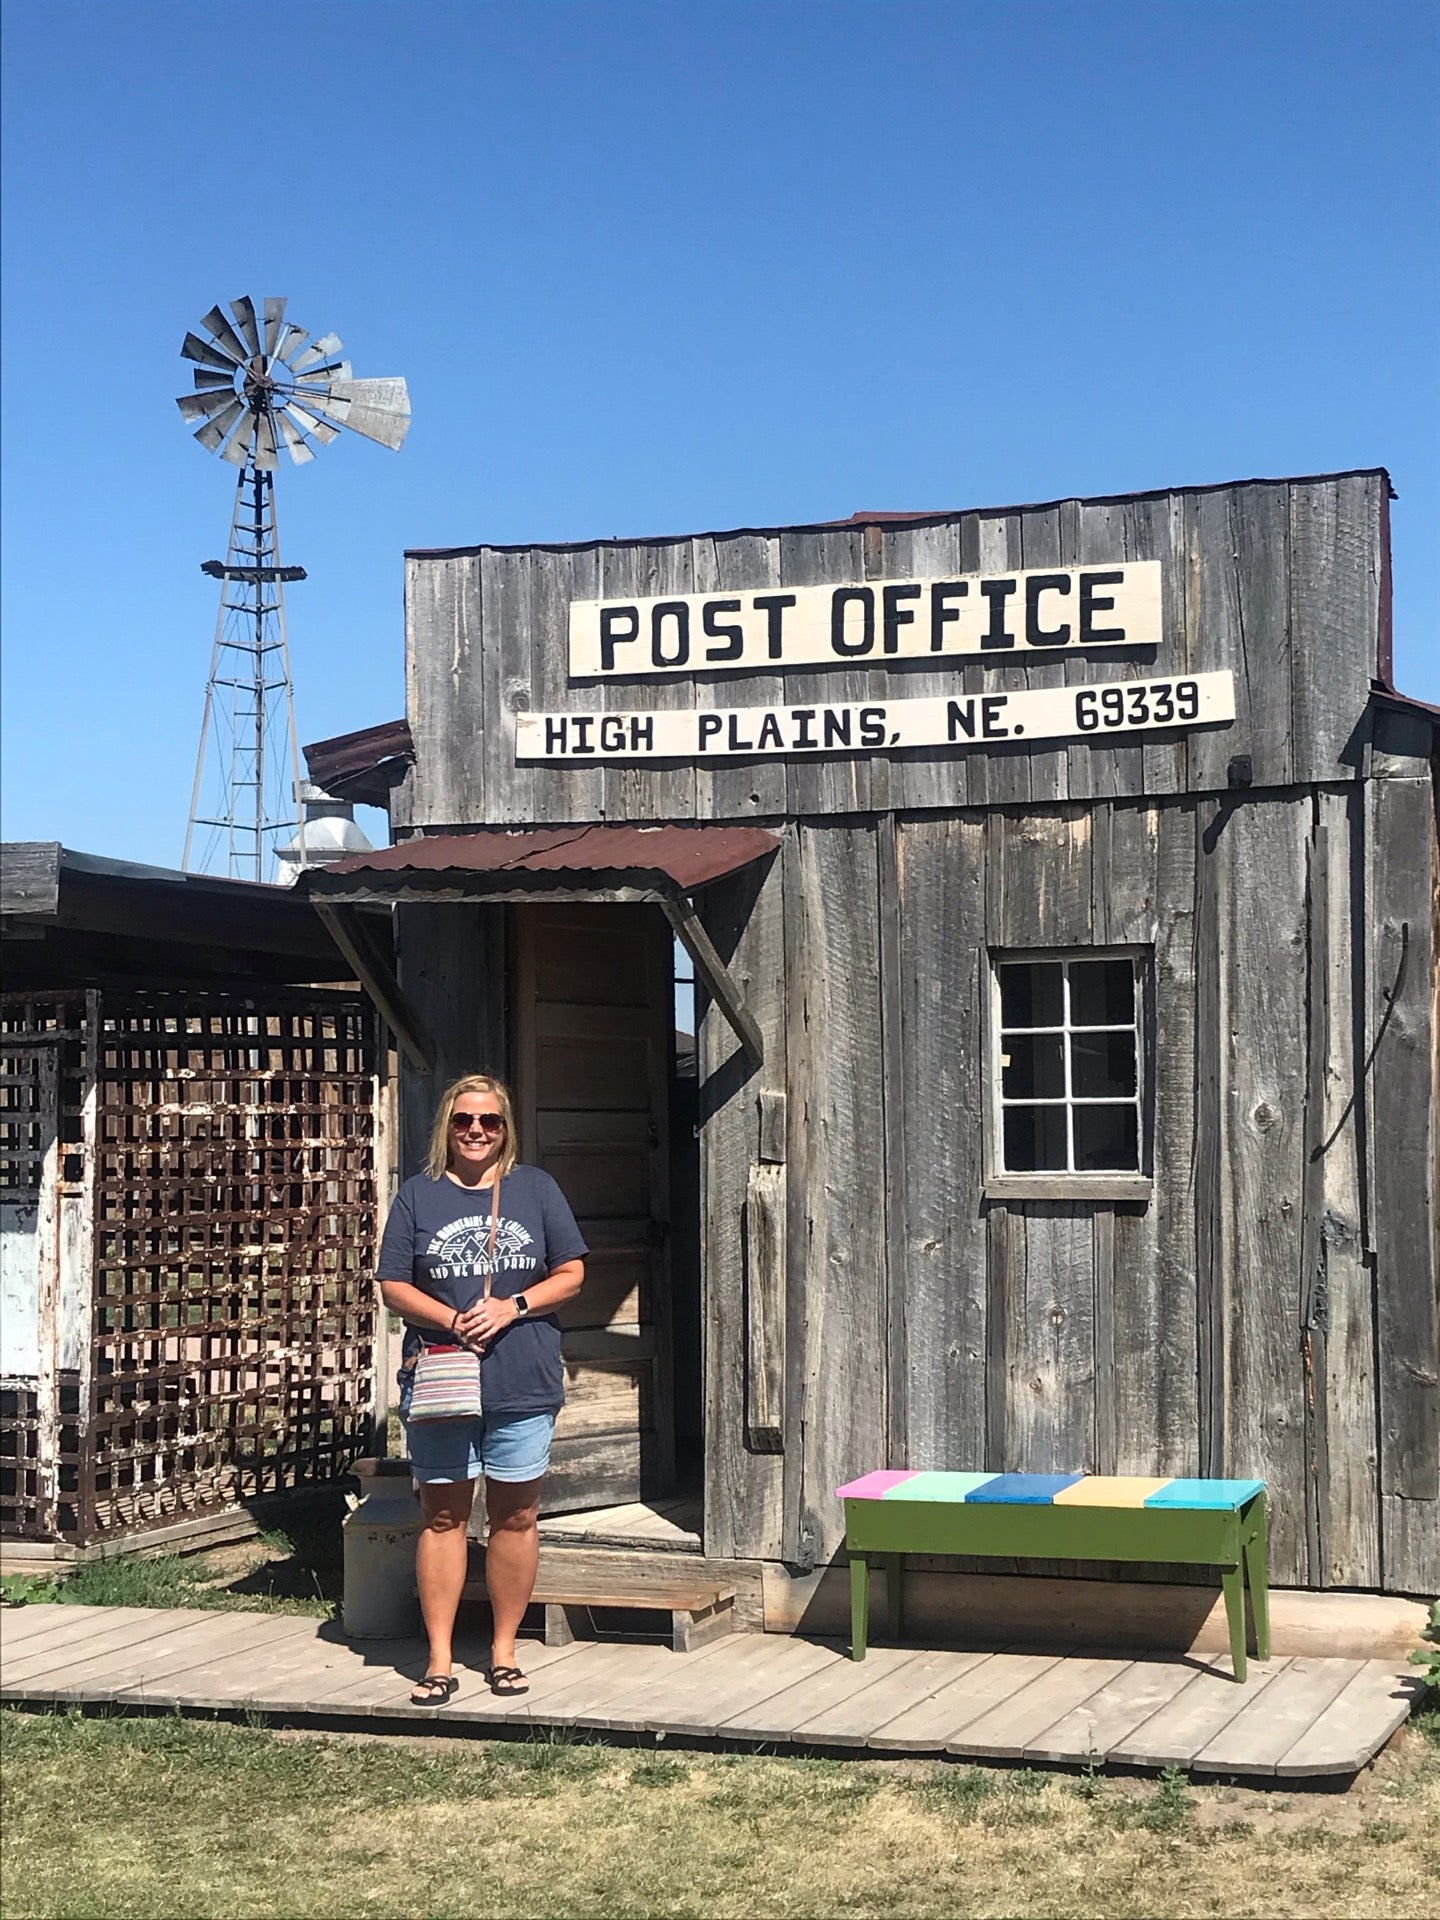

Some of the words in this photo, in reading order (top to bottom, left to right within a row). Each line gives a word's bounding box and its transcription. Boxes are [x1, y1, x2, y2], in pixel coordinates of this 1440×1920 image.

[600, 594, 797, 671] POST
[831, 571, 1126, 658] OFFICE
[545, 716, 654, 755] HIGH
[698, 708, 901, 752] PLAINS,
[947, 695, 1025, 740] NE.
[1075, 681, 1199, 731] 69339
[426, 1238, 444, 1255] THE
[436, 1215, 484, 1241] MOUNTAINS
[505, 1220, 535, 1245] CALLING
[429, 1266, 449, 1279] AND
[452, 1264, 469, 1277] WE
[504, 1257, 537, 1271] PARTY
